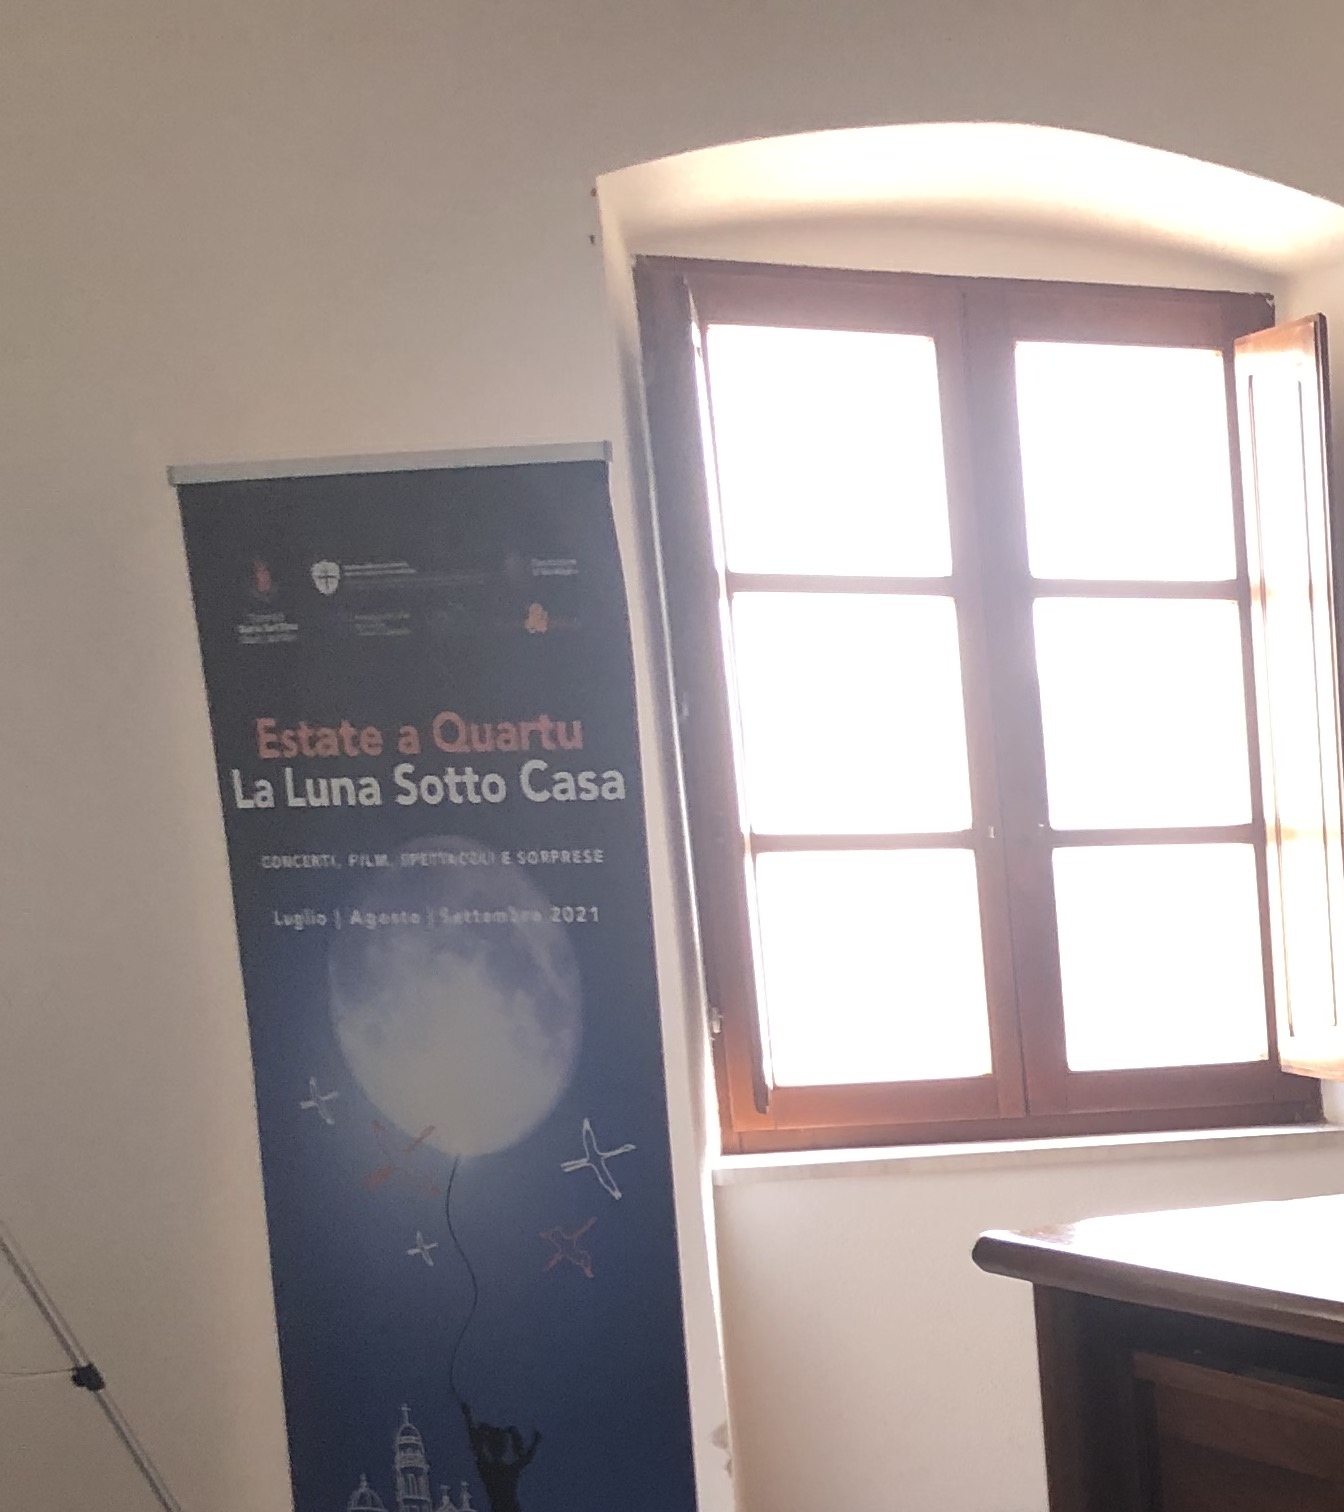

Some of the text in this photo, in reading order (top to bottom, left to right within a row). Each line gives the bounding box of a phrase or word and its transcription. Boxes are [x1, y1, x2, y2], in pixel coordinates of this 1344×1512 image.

[256, 711, 584, 759] Estate a Quartu
[231, 760, 627, 809] La Luna Sotto Casa
[400, 852, 496, 868] SPETTACOLI
[501, 851, 511, 865] E
[517, 849, 604, 865] SORPRESE
[273, 908, 327, 931] Luglio
[350, 908, 421, 930] Agosto
[439, 905, 543, 926] Settembre
[550, 905, 600, 924] 2021
